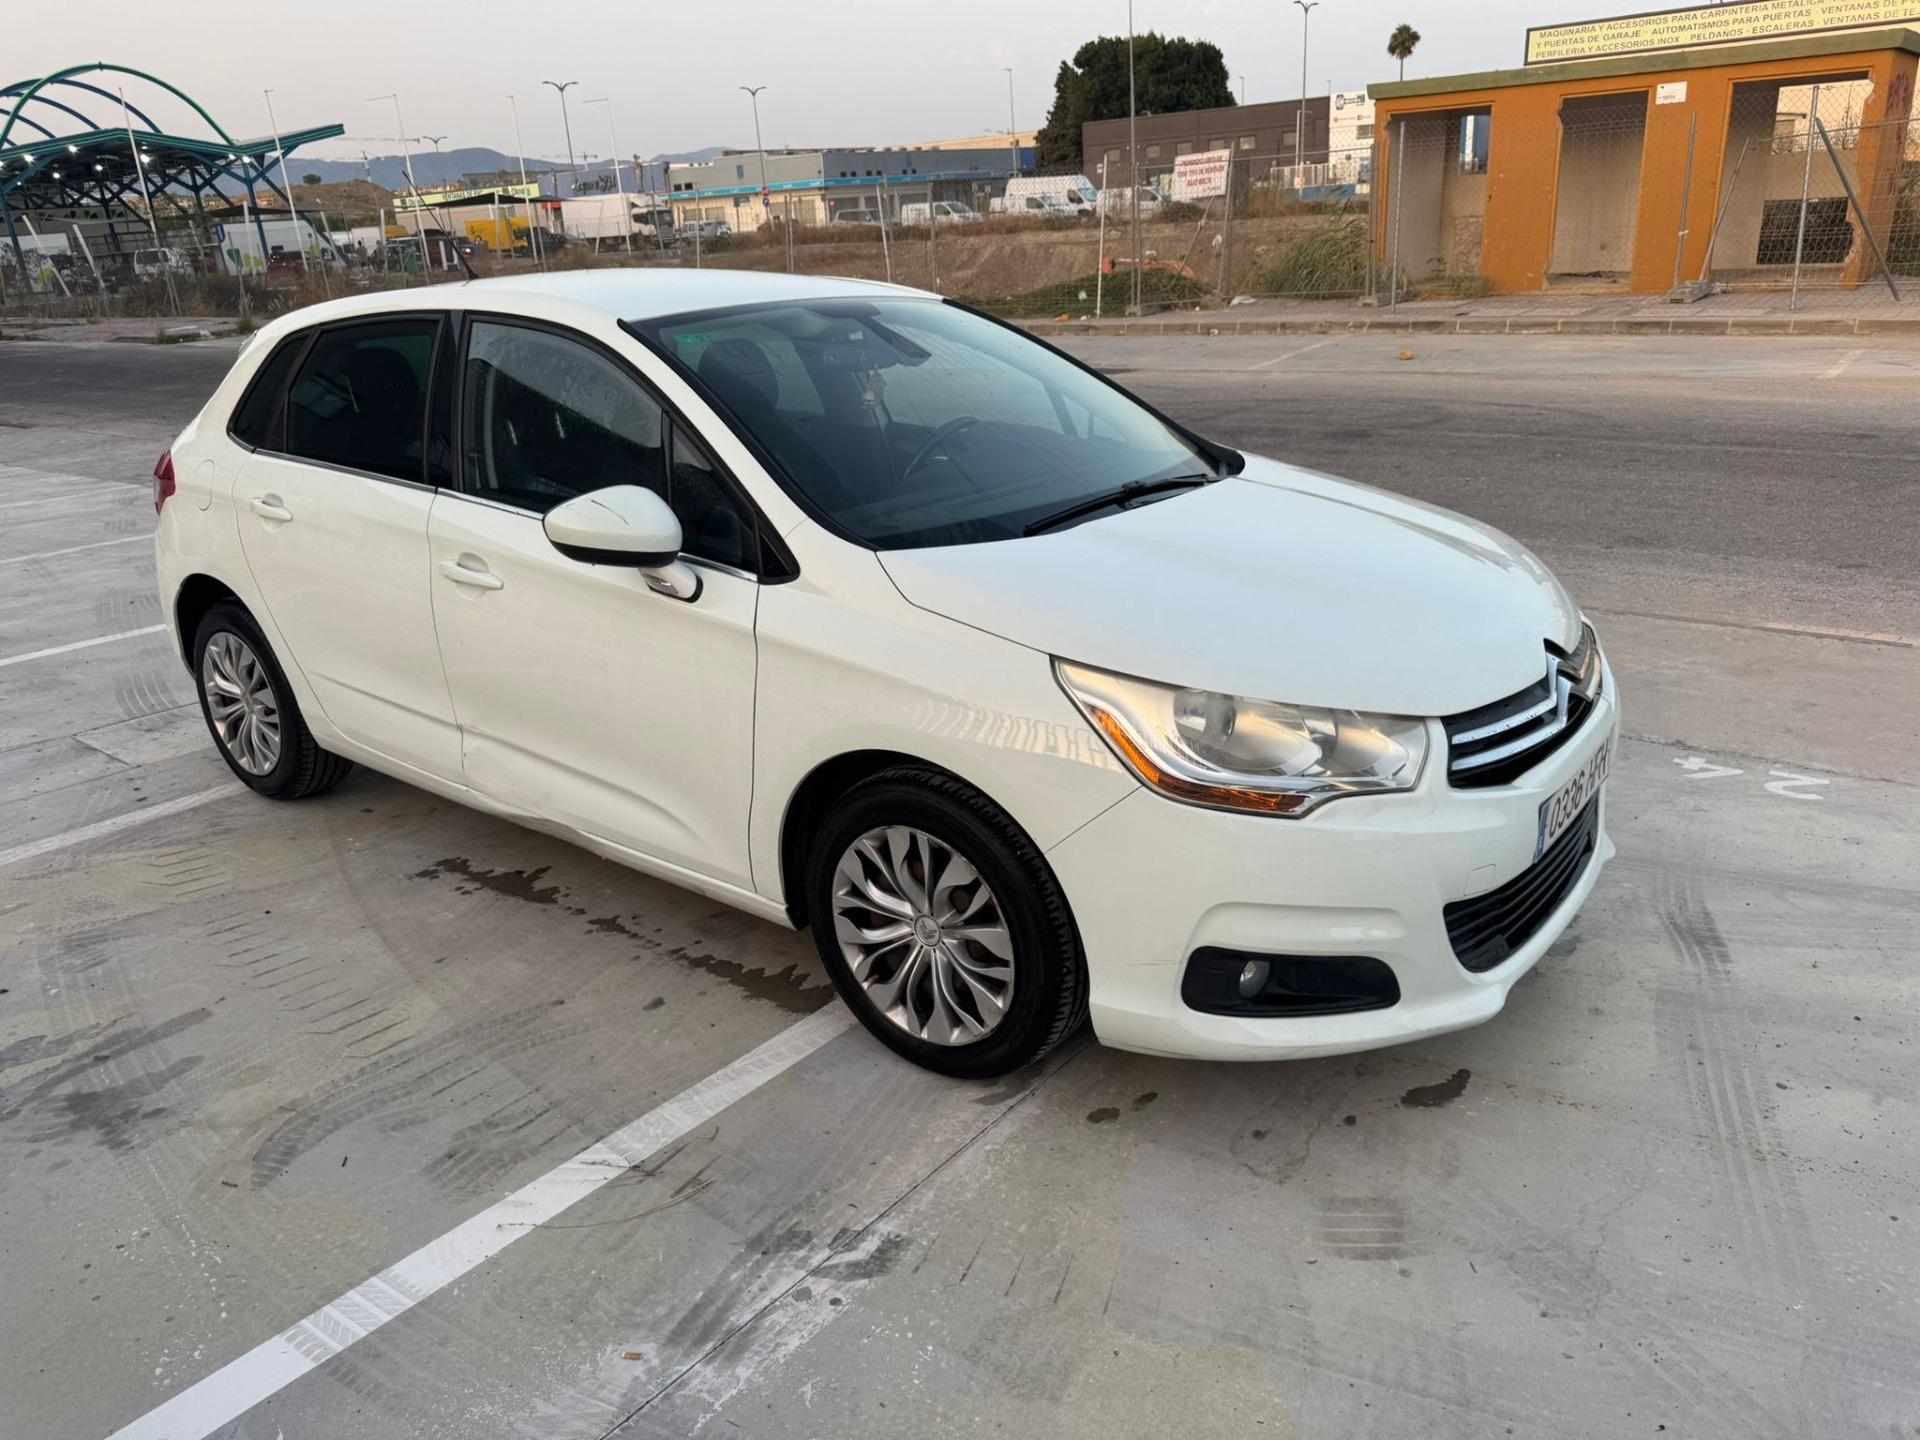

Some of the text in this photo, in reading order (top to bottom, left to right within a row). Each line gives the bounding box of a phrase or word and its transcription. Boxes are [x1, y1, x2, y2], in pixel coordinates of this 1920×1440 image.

[1535, 47, 1586, 59] PERFILERIA
[1596, 38, 1655, 52] ACCESORIOS
[1657, 36, 1680, 45] INOX
[1752, 19, 1814, 35] ESCALERAS
[1823, 11, 1880, 25] VENTANAS
[1884, 10, 1899, 19] DE
[1904, 8, 1920, 17] TE
[1540, 25, 1596, 39] MAQUINARIA
[1598, 24, 1604, 32] Y
[1606, 16, 1668, 31] ACCESORIOS
[1671, 13, 1698, 23] PARA
[1700, 4, 1768, 20] CARPINTERIA
[1543, 36, 1585, 48] PUERTAS
[1587, 34, 1600, 43] DE
[1603, 30, 1641, 42] GARAJE
[1651, 20, 1730, 36] AUTOMATISMOS
[1732, 16, 1760, 25] PARA
[1763, 9, 1812, 22] PUERTAS
[1821, 1, 1880, 15] VENTANAS
[1883, 0, 1899, 8] DE
[1549, 770, 1585, 839] 0336
